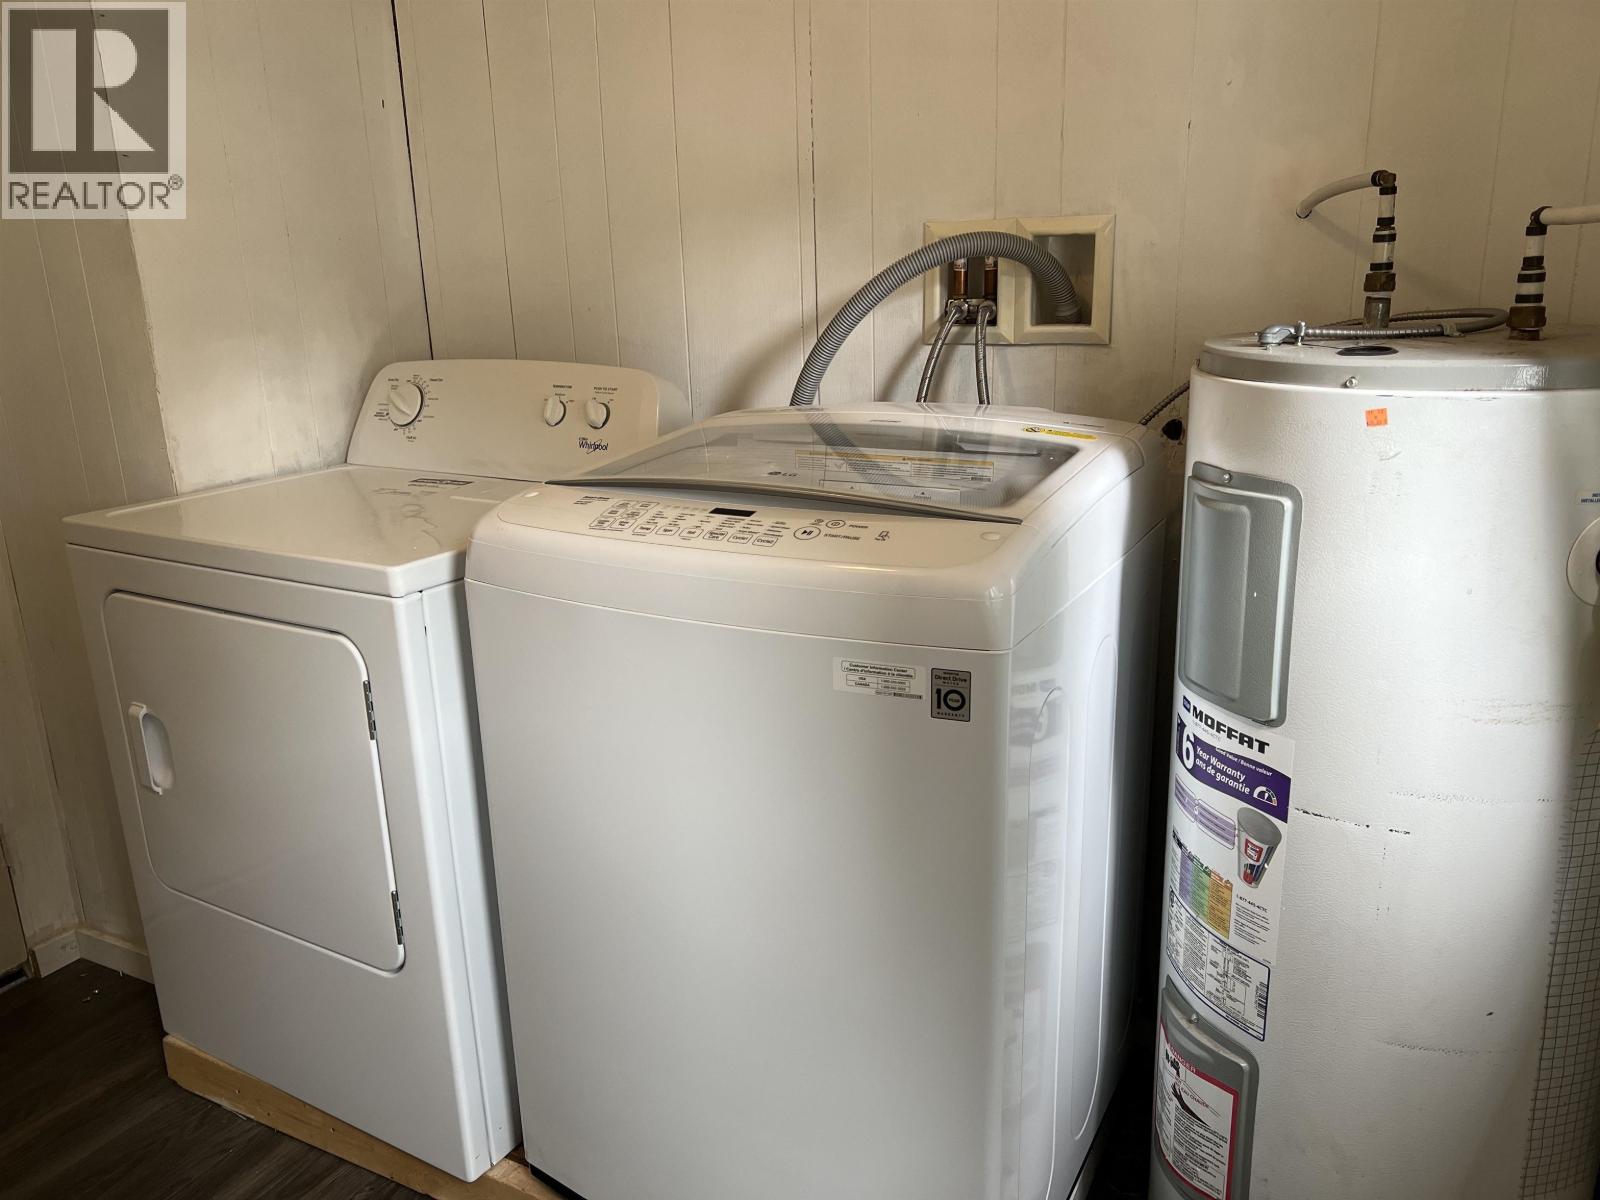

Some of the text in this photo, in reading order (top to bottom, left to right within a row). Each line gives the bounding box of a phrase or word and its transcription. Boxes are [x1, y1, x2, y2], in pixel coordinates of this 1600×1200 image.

[579, 439, 608, 454] Whirlpool
[936, 688, 966, 711] 10
[1192, 705, 1270, 754] MOFFAT
[1182, 727, 1195, 770] 6
[1196, 745, 1246, 782] Year Warranty
[1195, 758, 1251, 795] ans de garantie
